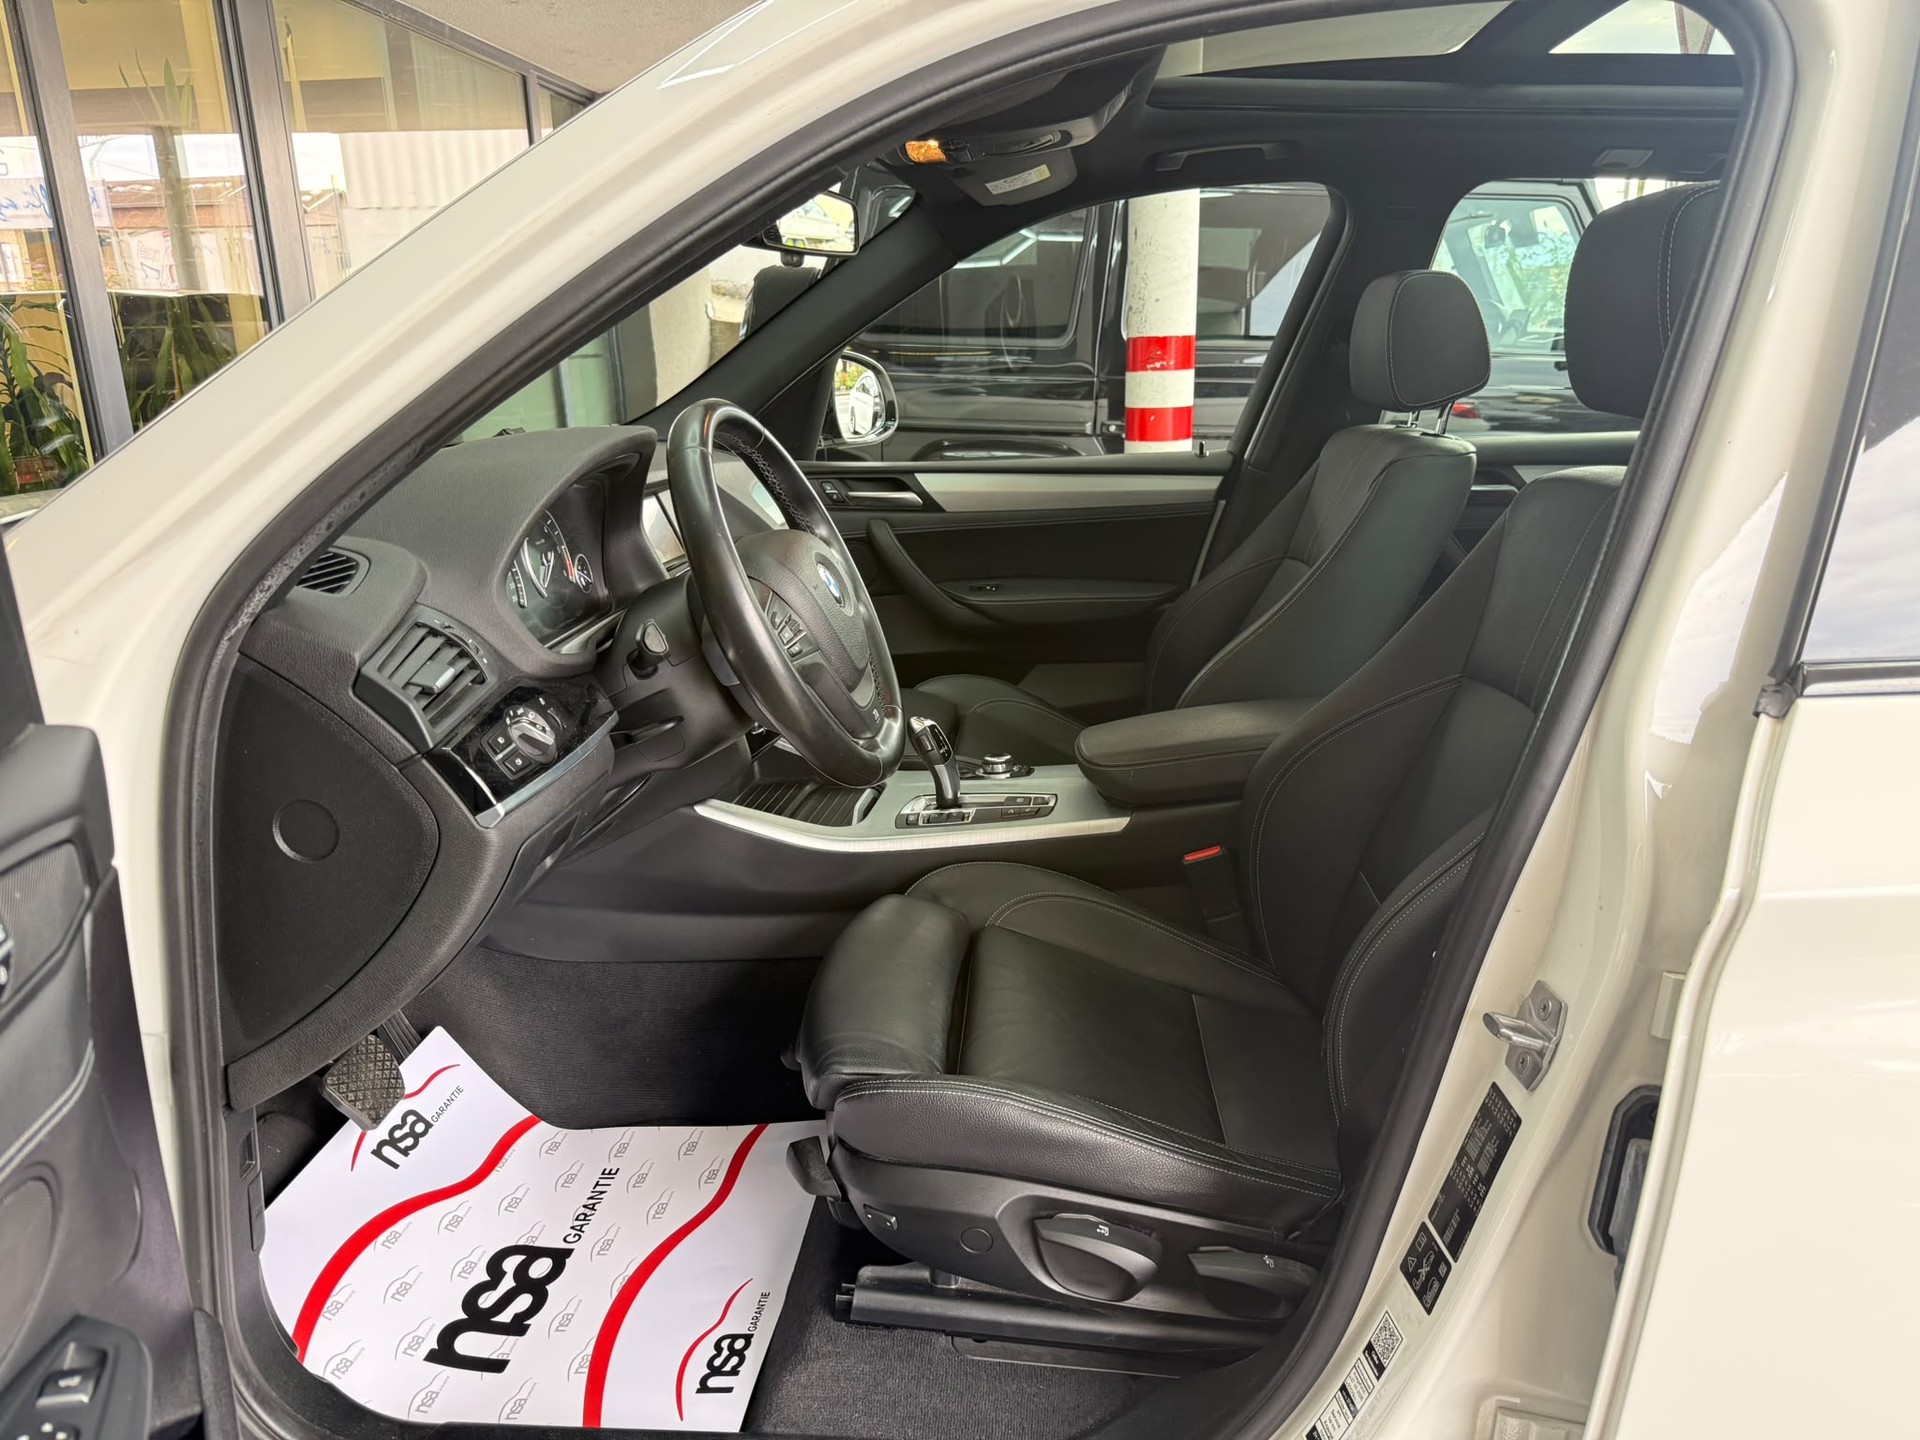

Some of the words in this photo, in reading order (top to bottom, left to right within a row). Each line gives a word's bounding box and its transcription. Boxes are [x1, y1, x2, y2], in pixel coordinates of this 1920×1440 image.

[370, 1109, 434, 1170] nsa
[431, 1085, 464, 1123] GARANTIE
[423, 1244, 575, 1374] nsa
[563, 1167, 621, 1244] GARANTIE
[695, 1333, 755, 1394] nsa
[747, 1291, 771, 1333] GARANTIE
